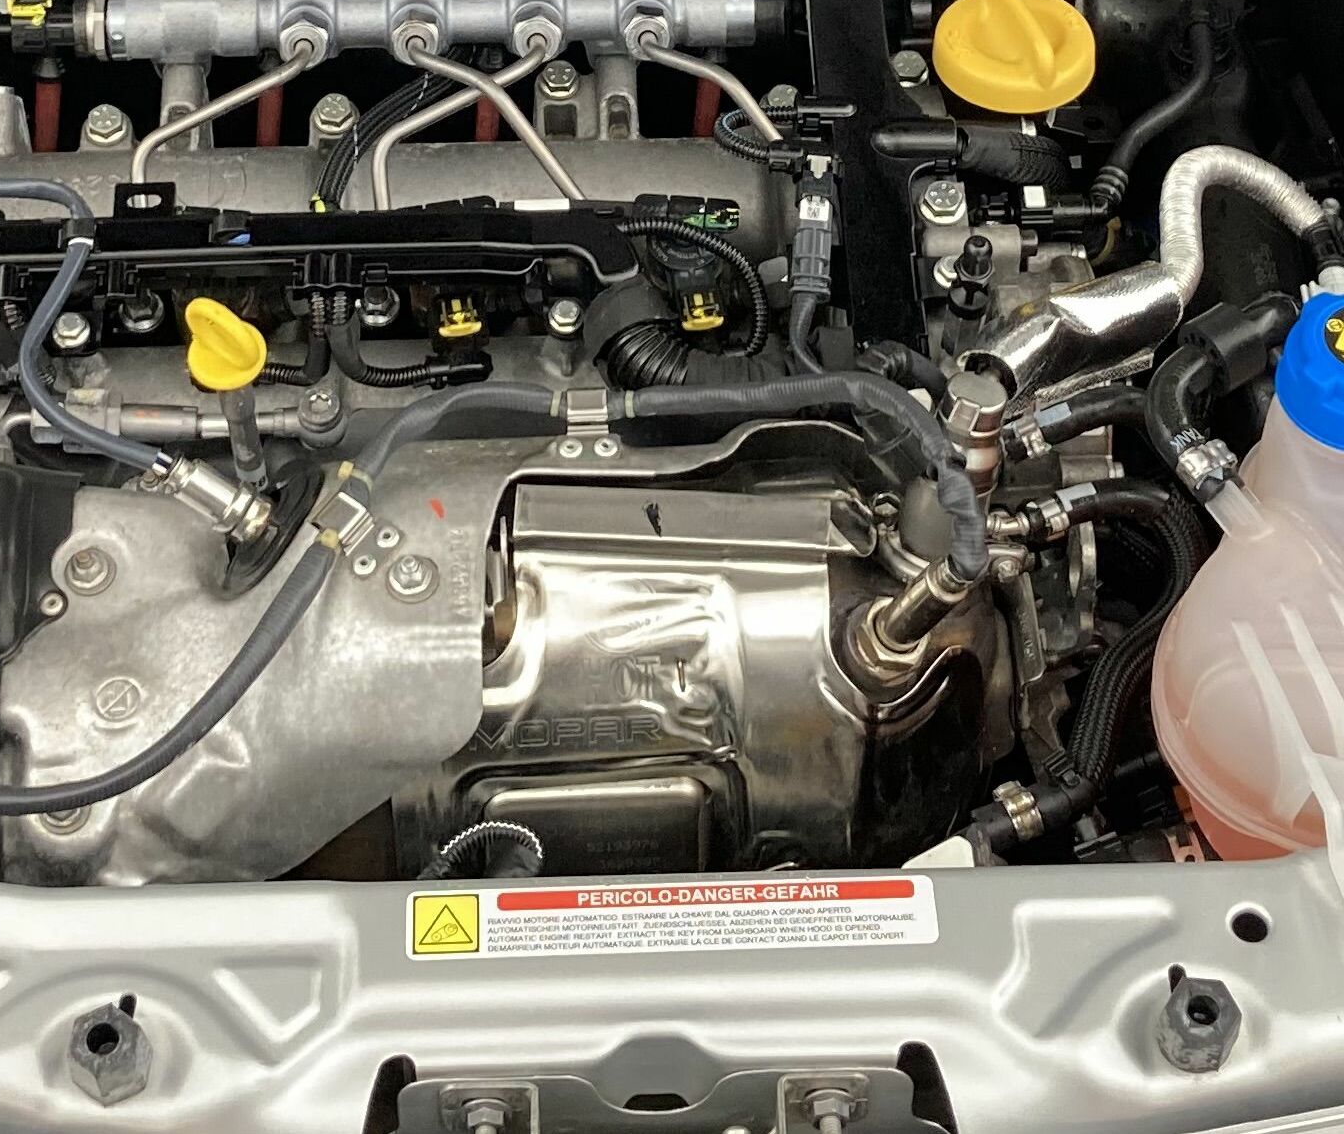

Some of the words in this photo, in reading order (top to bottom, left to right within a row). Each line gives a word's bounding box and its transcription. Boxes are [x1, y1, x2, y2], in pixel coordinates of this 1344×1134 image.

[582, 654, 662, 703] HOT
[468, 715, 664, 751] MOPAR
[577, 883, 839, 906] PERICOLO-DANGER-GEFAHR
[487, 924, 559, 933] AUTOMATISCHER
[642, 919, 726, 928] ZUENDSCHLUESSEL
[729, 917, 771, 925] ABZIEHEN
[789, 915, 852, 924] GEOEFFNETER
[523, 915, 559, 923] MOTORE
[681, 910, 712, 918] CHIAVE
[732, 908, 769, 916] QUADRO
[779, 907, 814, 915] COFANO
[487, 934, 535, 942] AUTOMATIC
[539, 933, 569, 941] ENGINE
[617, 930, 655, 938] EXTRACT
[723, 926, 776, 935] DASHBOARD
[487, 943, 541, 952] DEMARREUR
[543, 942, 580, 950] MOTEUR
[647, 938, 688, 946] EXTRAIRE
[703, 937, 719, 945] CLE
[735, 935, 774, 943] CONTACT
[821, 933, 849, 941] CAPOT
[852, 932, 867, 940] EST
